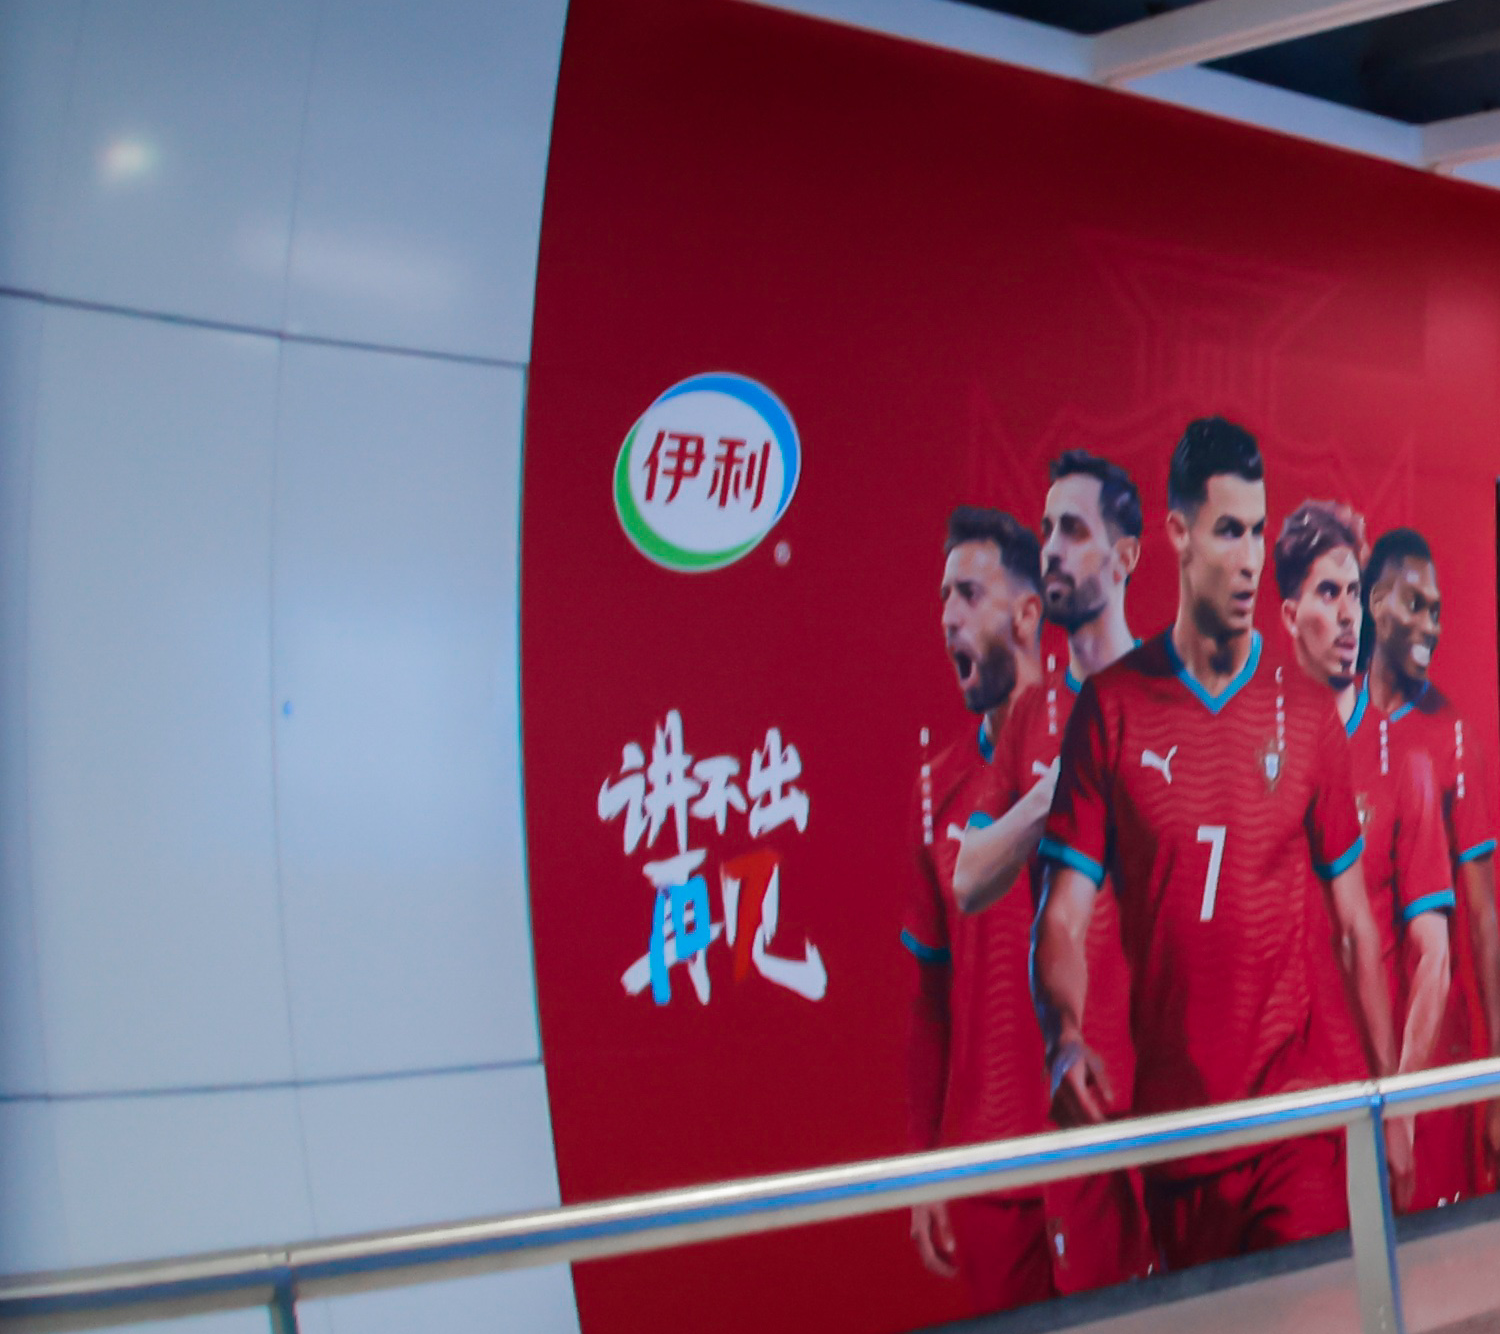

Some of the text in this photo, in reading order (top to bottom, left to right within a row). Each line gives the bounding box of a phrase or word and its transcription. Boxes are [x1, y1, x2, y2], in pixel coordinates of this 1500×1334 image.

[643, 429, 773, 512] 伊利
[597, 709, 811, 856] 讲不出
[1196, 824, 1227, 922] 7
